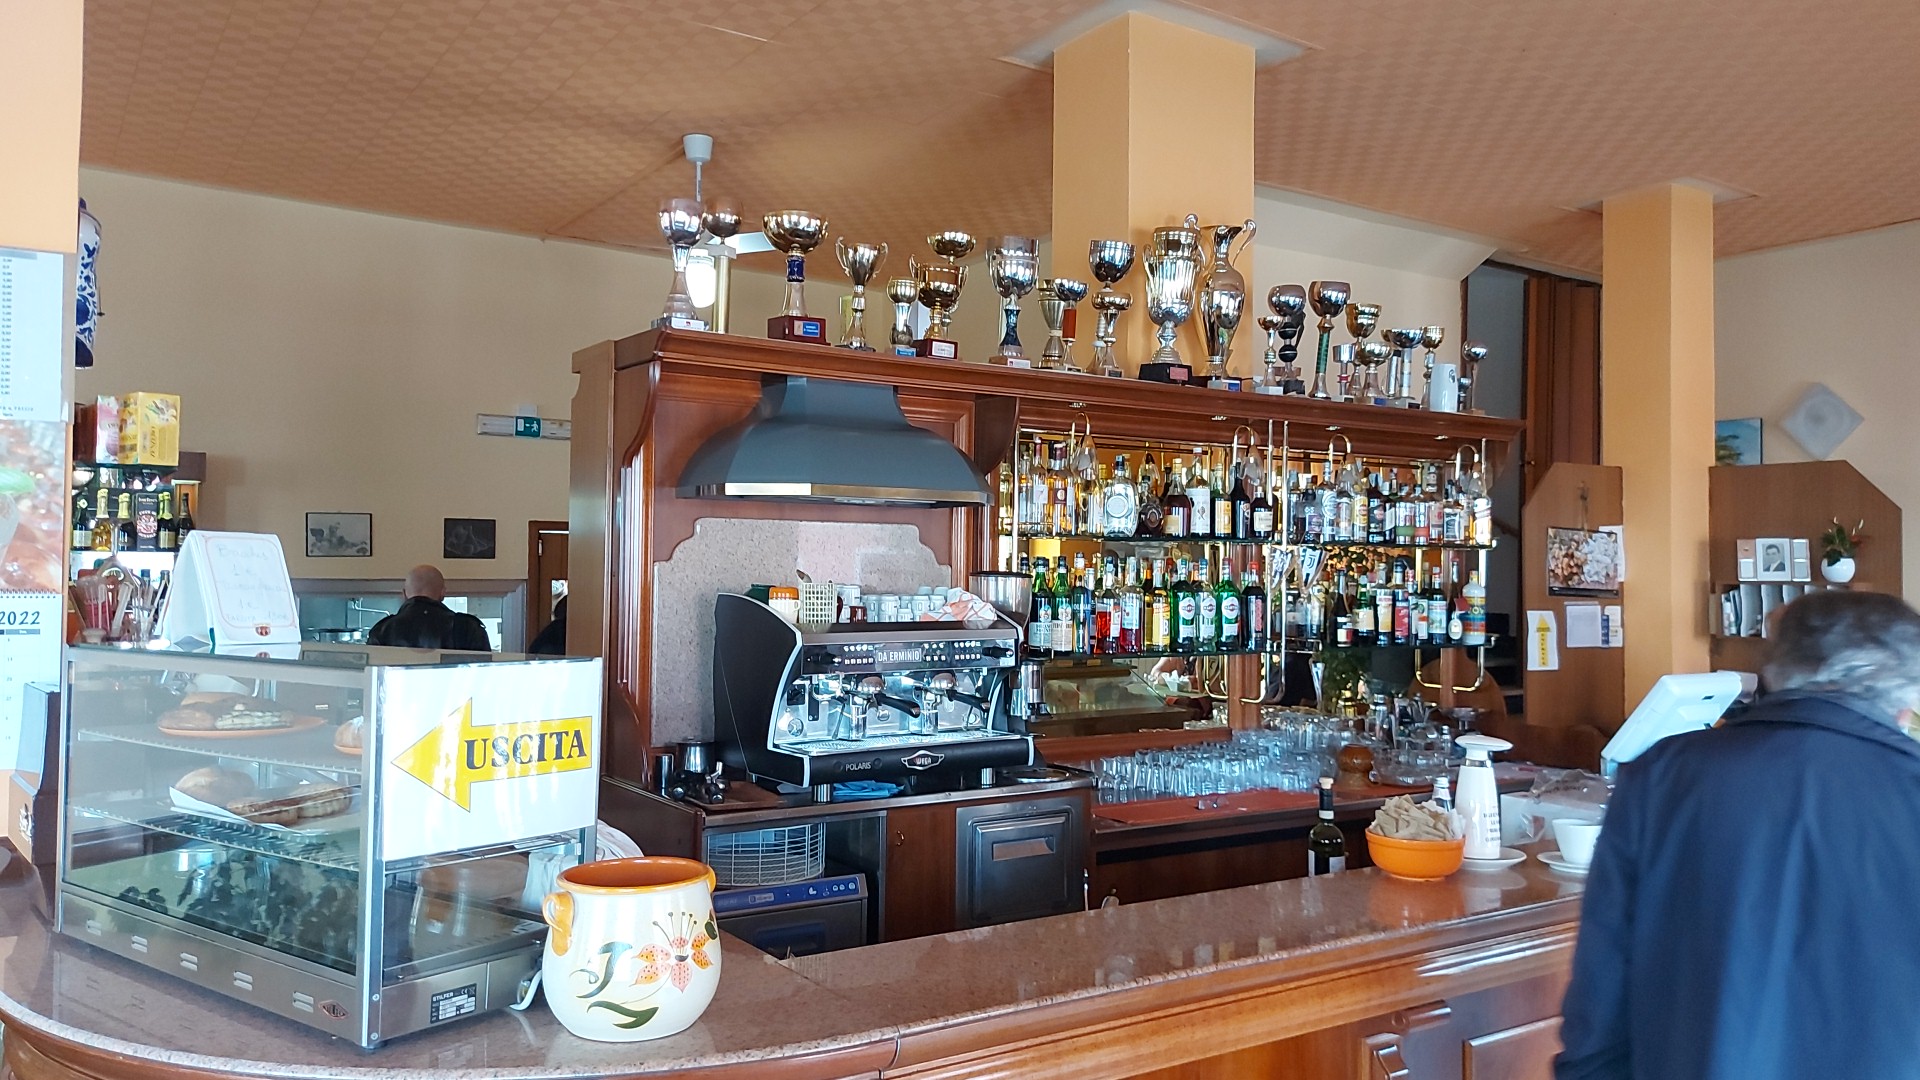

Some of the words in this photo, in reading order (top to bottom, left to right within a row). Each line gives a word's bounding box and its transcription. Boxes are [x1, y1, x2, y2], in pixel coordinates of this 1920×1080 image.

[0, 611, 41, 625] 2022
[878, 652, 888, 662] DA
[889, 650, 920, 661] ERMINIO
[464, 729, 587, 770] USCITA
[845, 762, 872, 772] POLARIS
